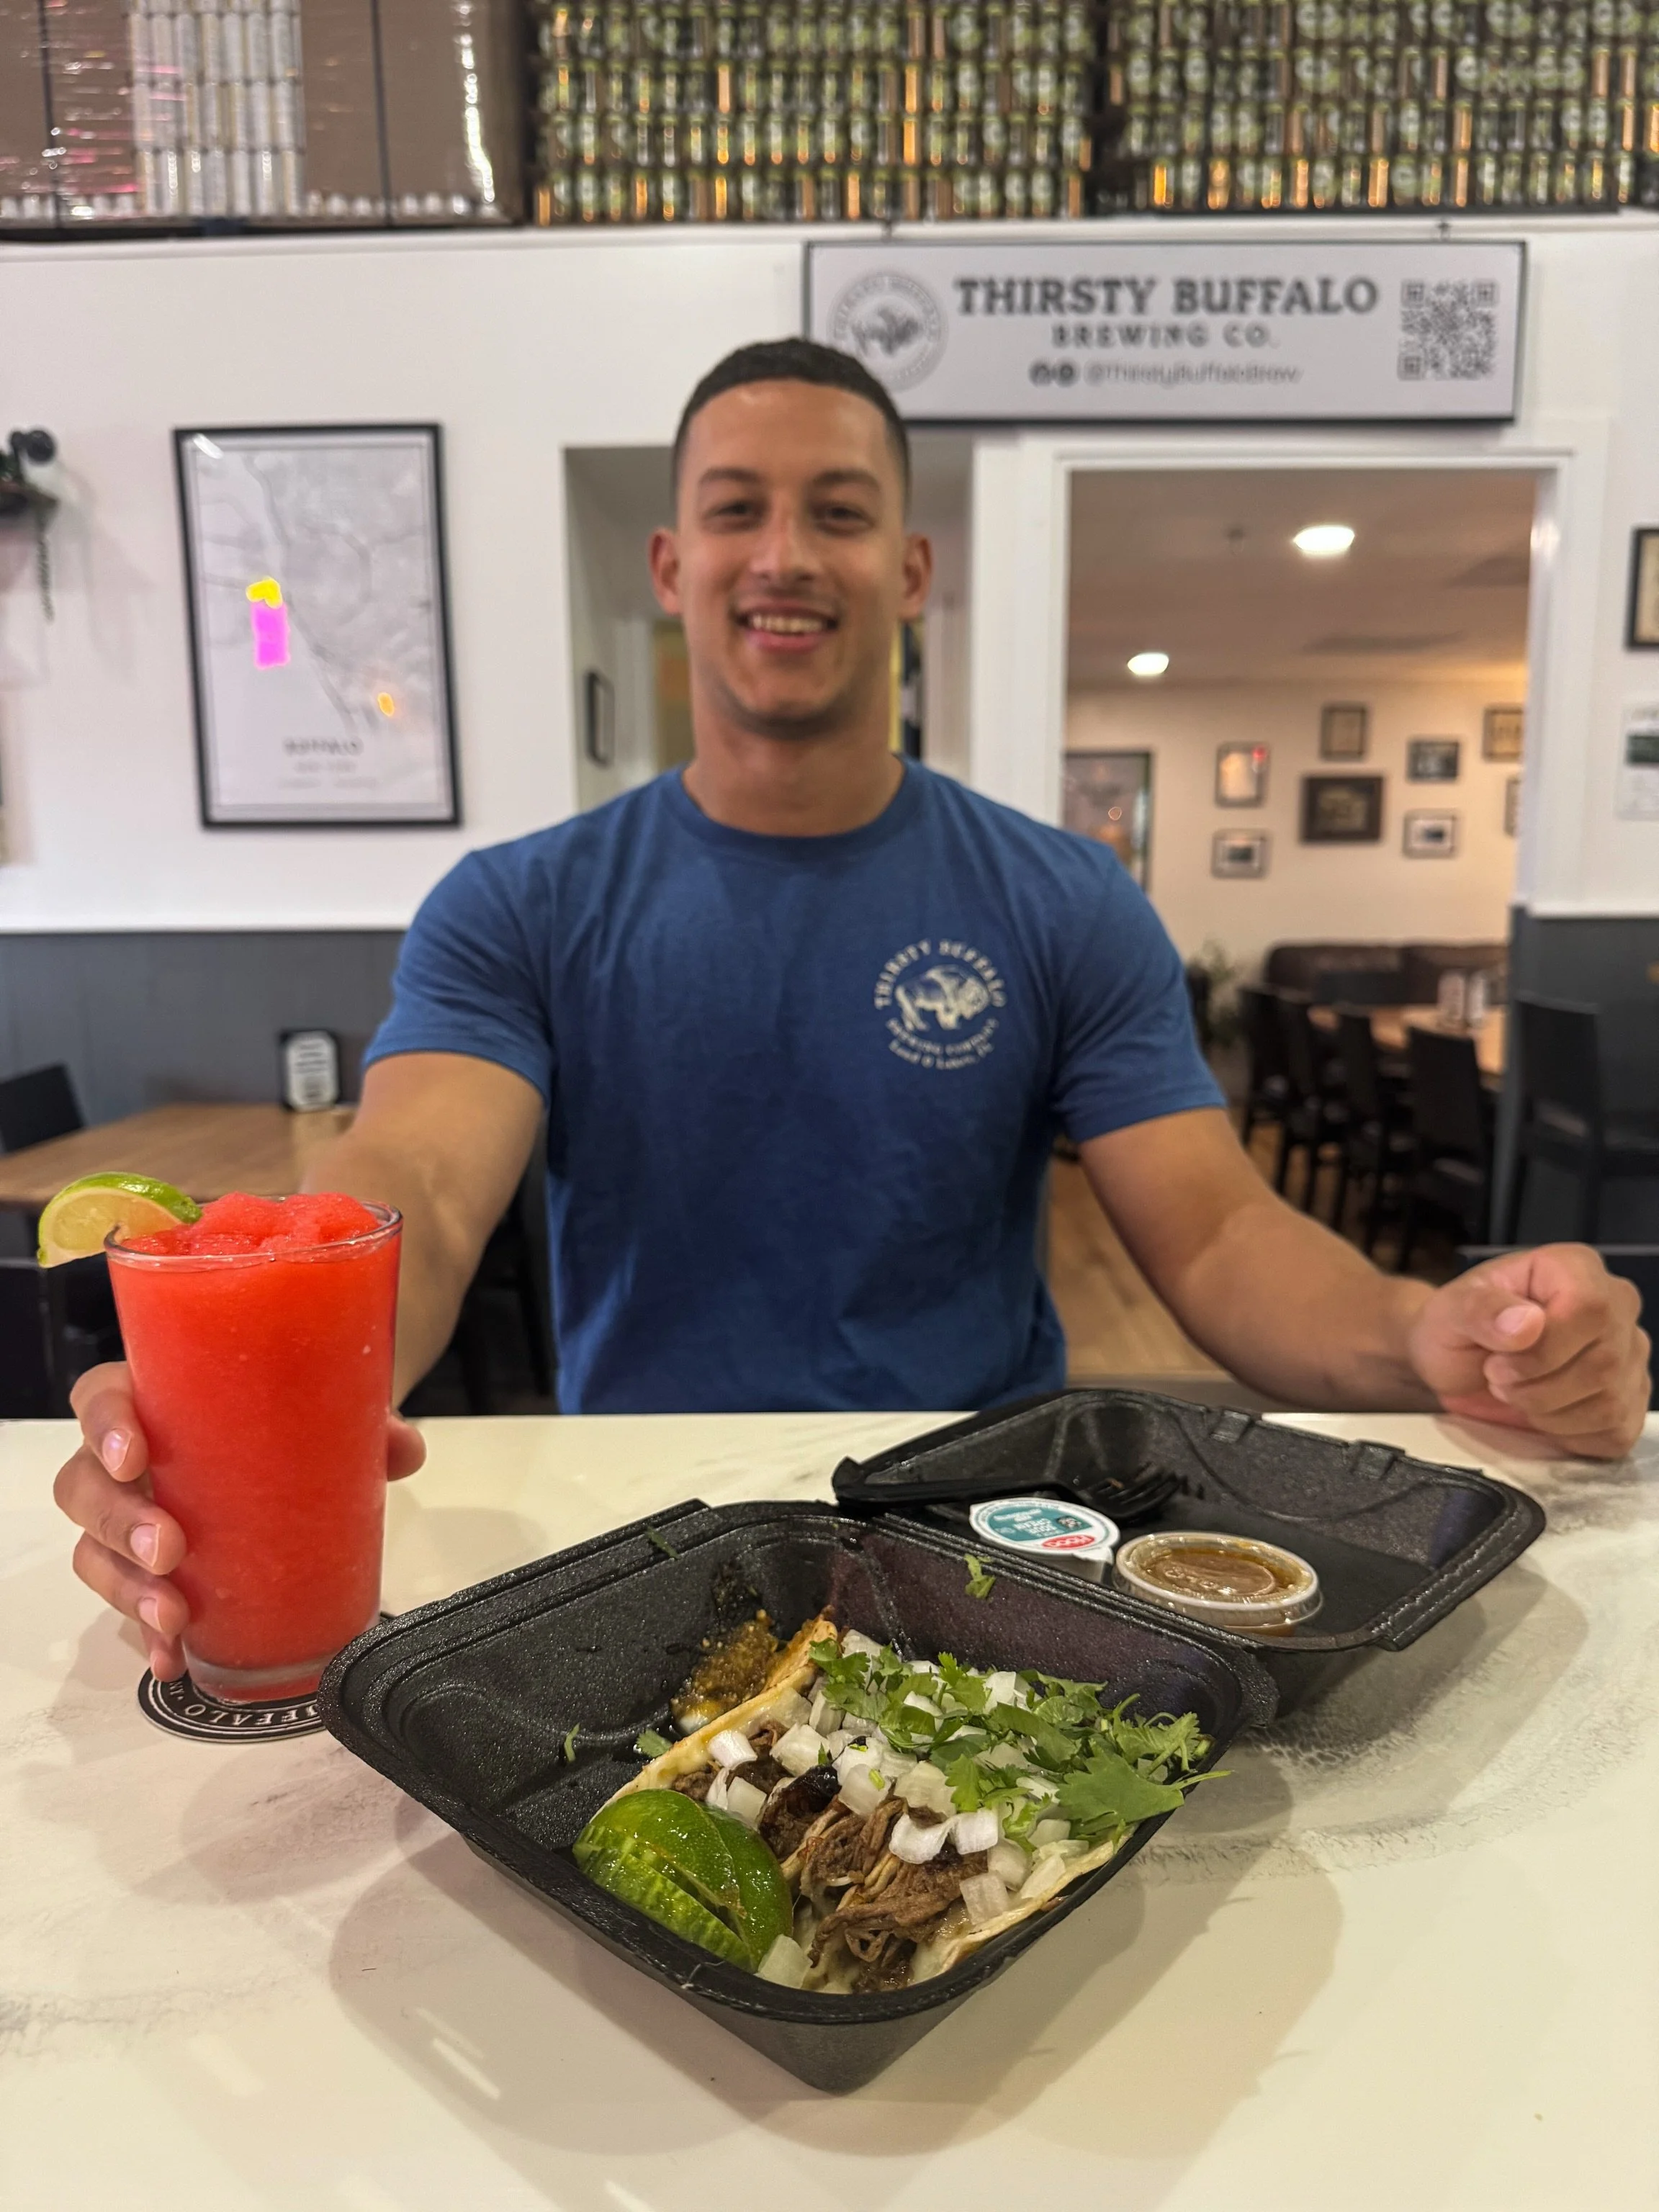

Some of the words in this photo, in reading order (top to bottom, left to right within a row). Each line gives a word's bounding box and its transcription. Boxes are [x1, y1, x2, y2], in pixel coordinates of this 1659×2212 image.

[954, 276, 1156, 315] THIRSTY
[1172, 276, 1378, 315] BUFFALO
[1051, 323, 1209, 348] BREWING
[1223, 322, 1280, 349] CO.
[874, 938, 932, 1010] THIRSTY
[939, 938, 1007, 1007] BUFFALO
[184, 1704, 318, 1726] UFFALO
